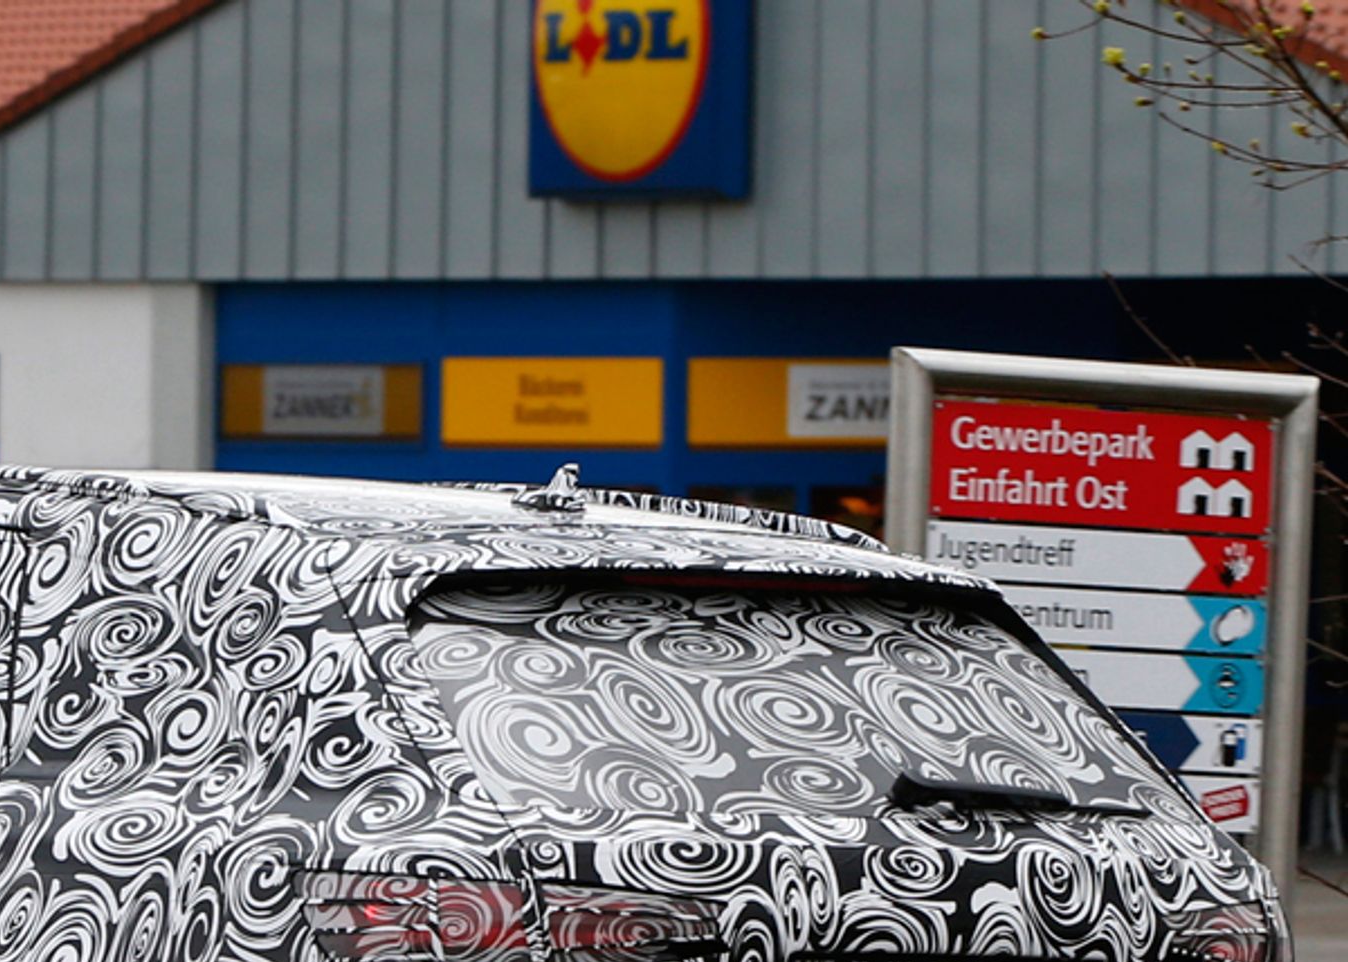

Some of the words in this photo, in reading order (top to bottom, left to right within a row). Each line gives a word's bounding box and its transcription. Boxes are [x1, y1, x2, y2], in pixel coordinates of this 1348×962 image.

[951, 416, 1155, 467] Gewerbepark
[949, 467, 1068, 508] Einfahrt
[1076, 475, 1129, 511] Ost
[935, 533, 1077, 569] Jugendtreff
[1013, 602, 1114, 631] entrum
